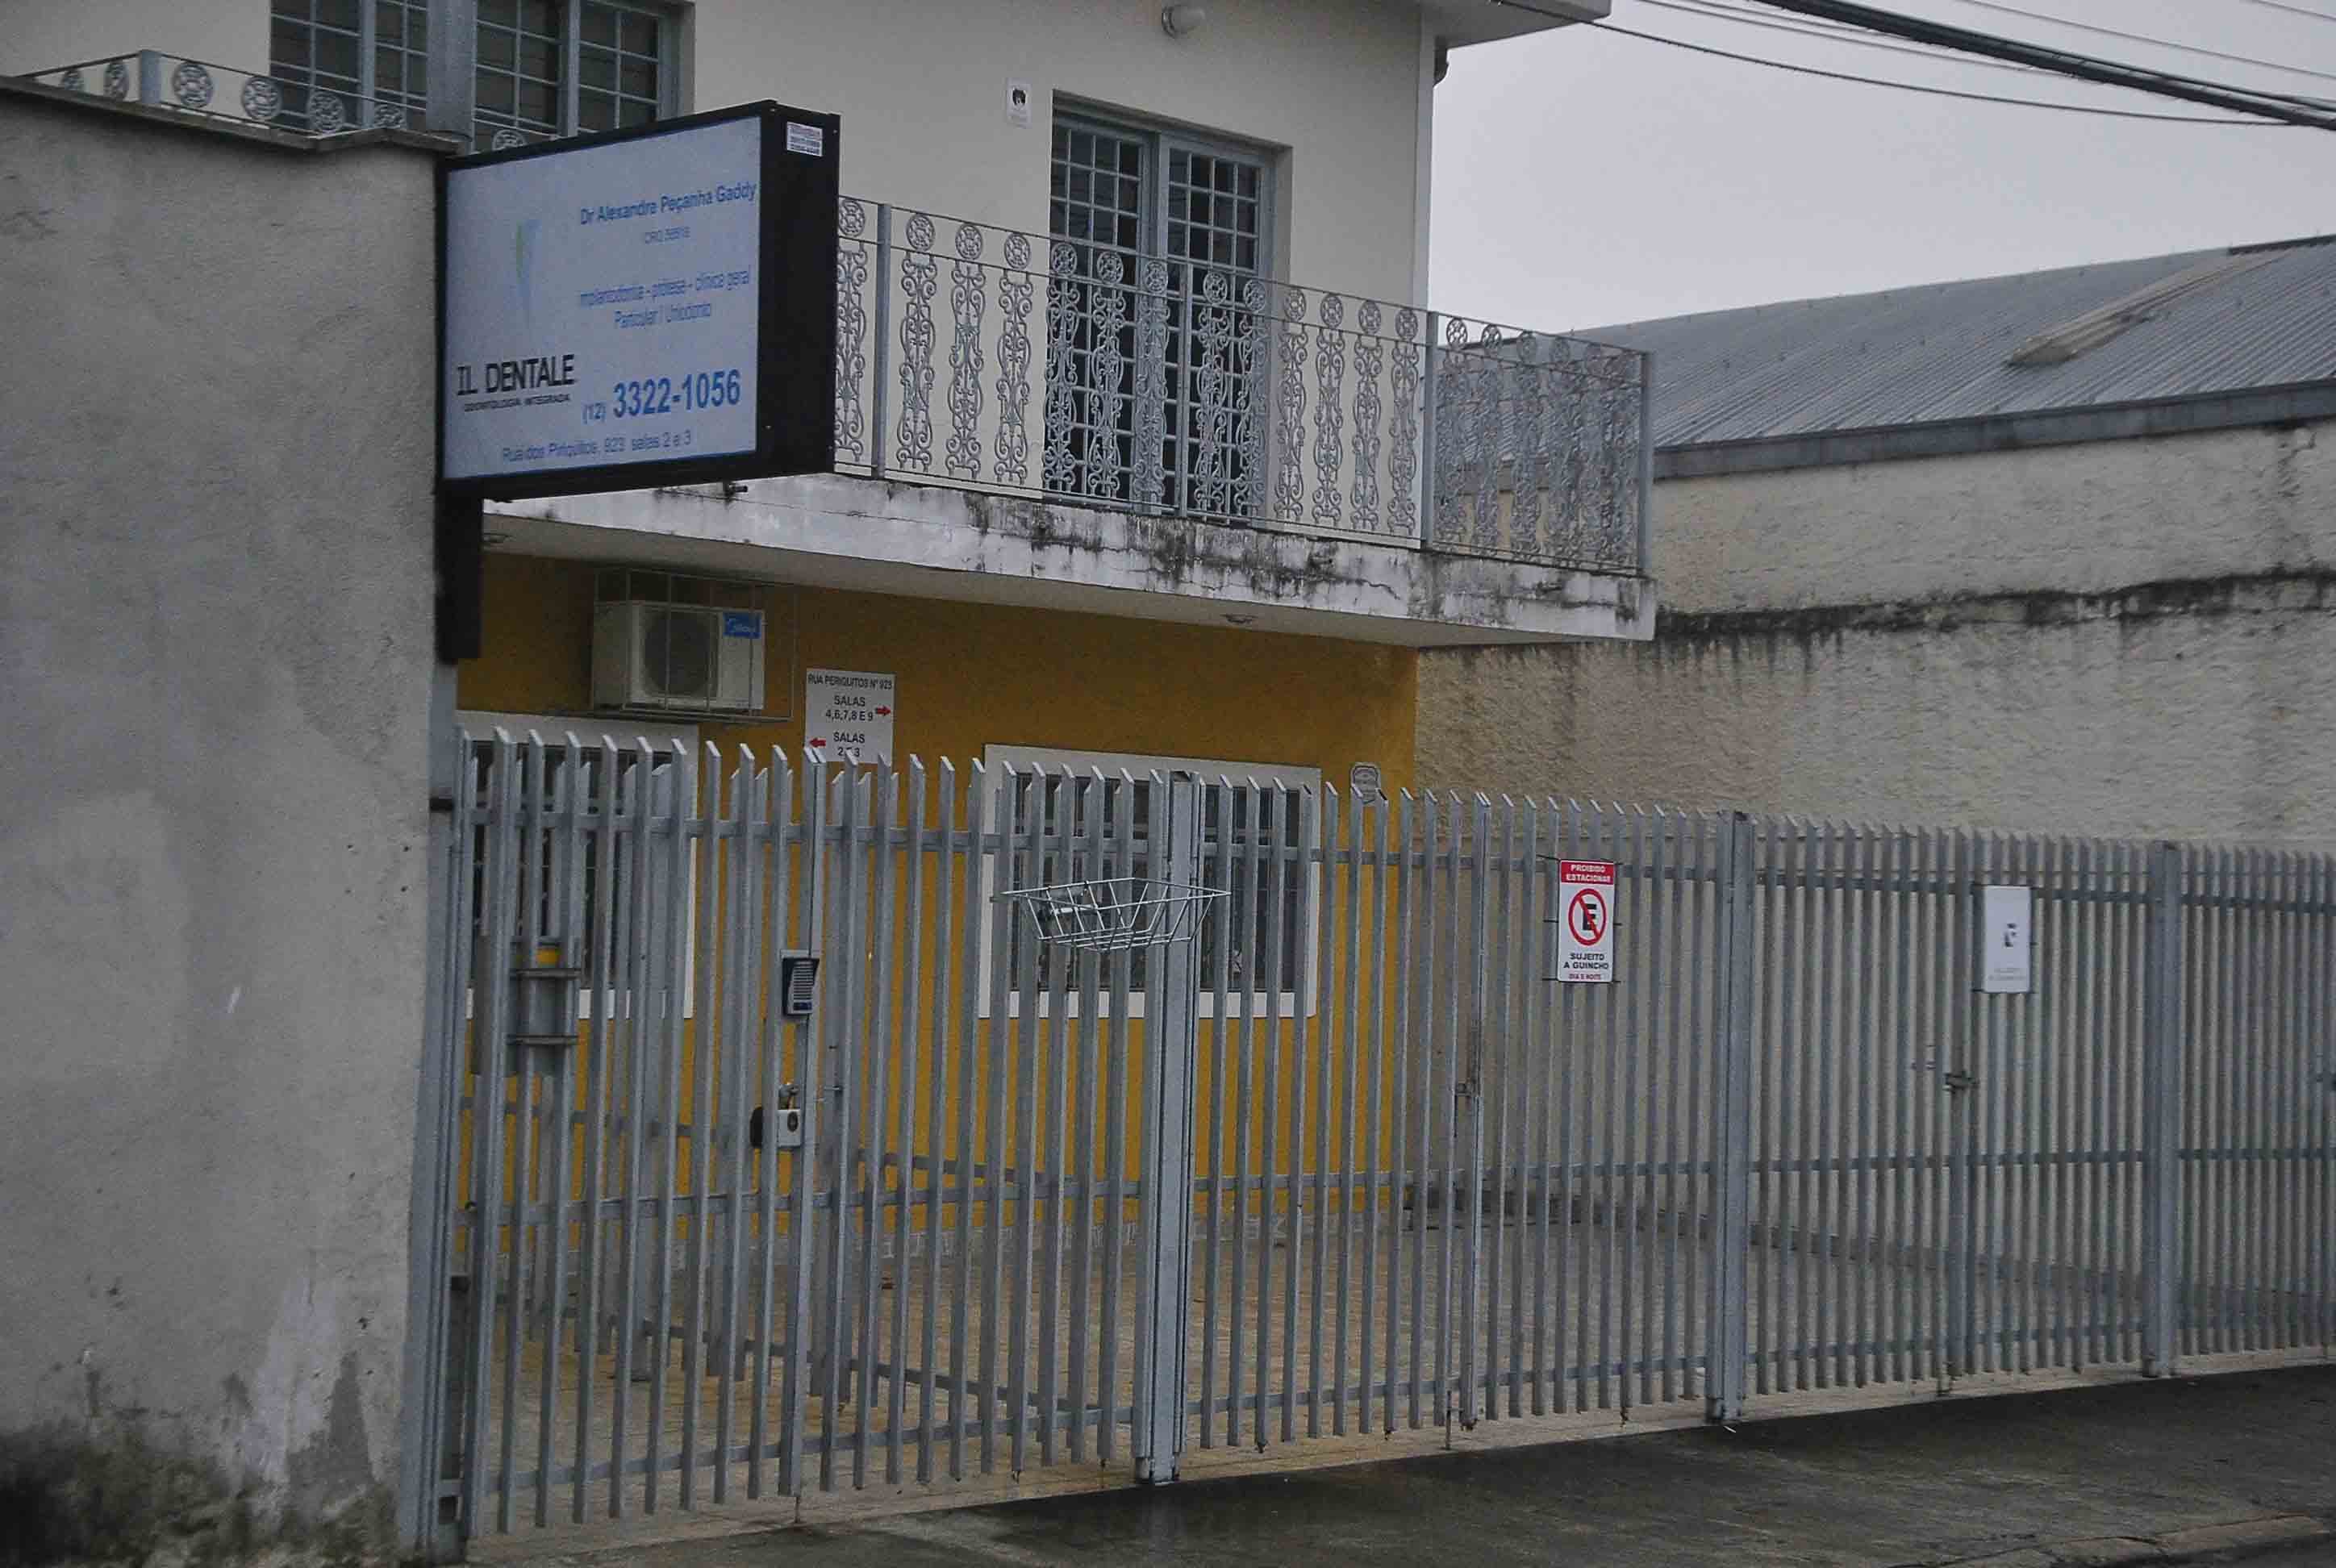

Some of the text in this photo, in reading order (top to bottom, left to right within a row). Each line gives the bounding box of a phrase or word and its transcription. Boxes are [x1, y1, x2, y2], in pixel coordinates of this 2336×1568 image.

[485, 353, 575, 394] DENTALE
[613, 369, 741, 418] 3322-1056
[834, 694, 866, 707] SALAS
[859, 711, 866, 721] E
[867, 711, 874, 722] 9
[833, 732, 866, 744] SALAS
[837, 746, 844, 757] 2
[1569, 953, 1605, 961] SUJEITO
